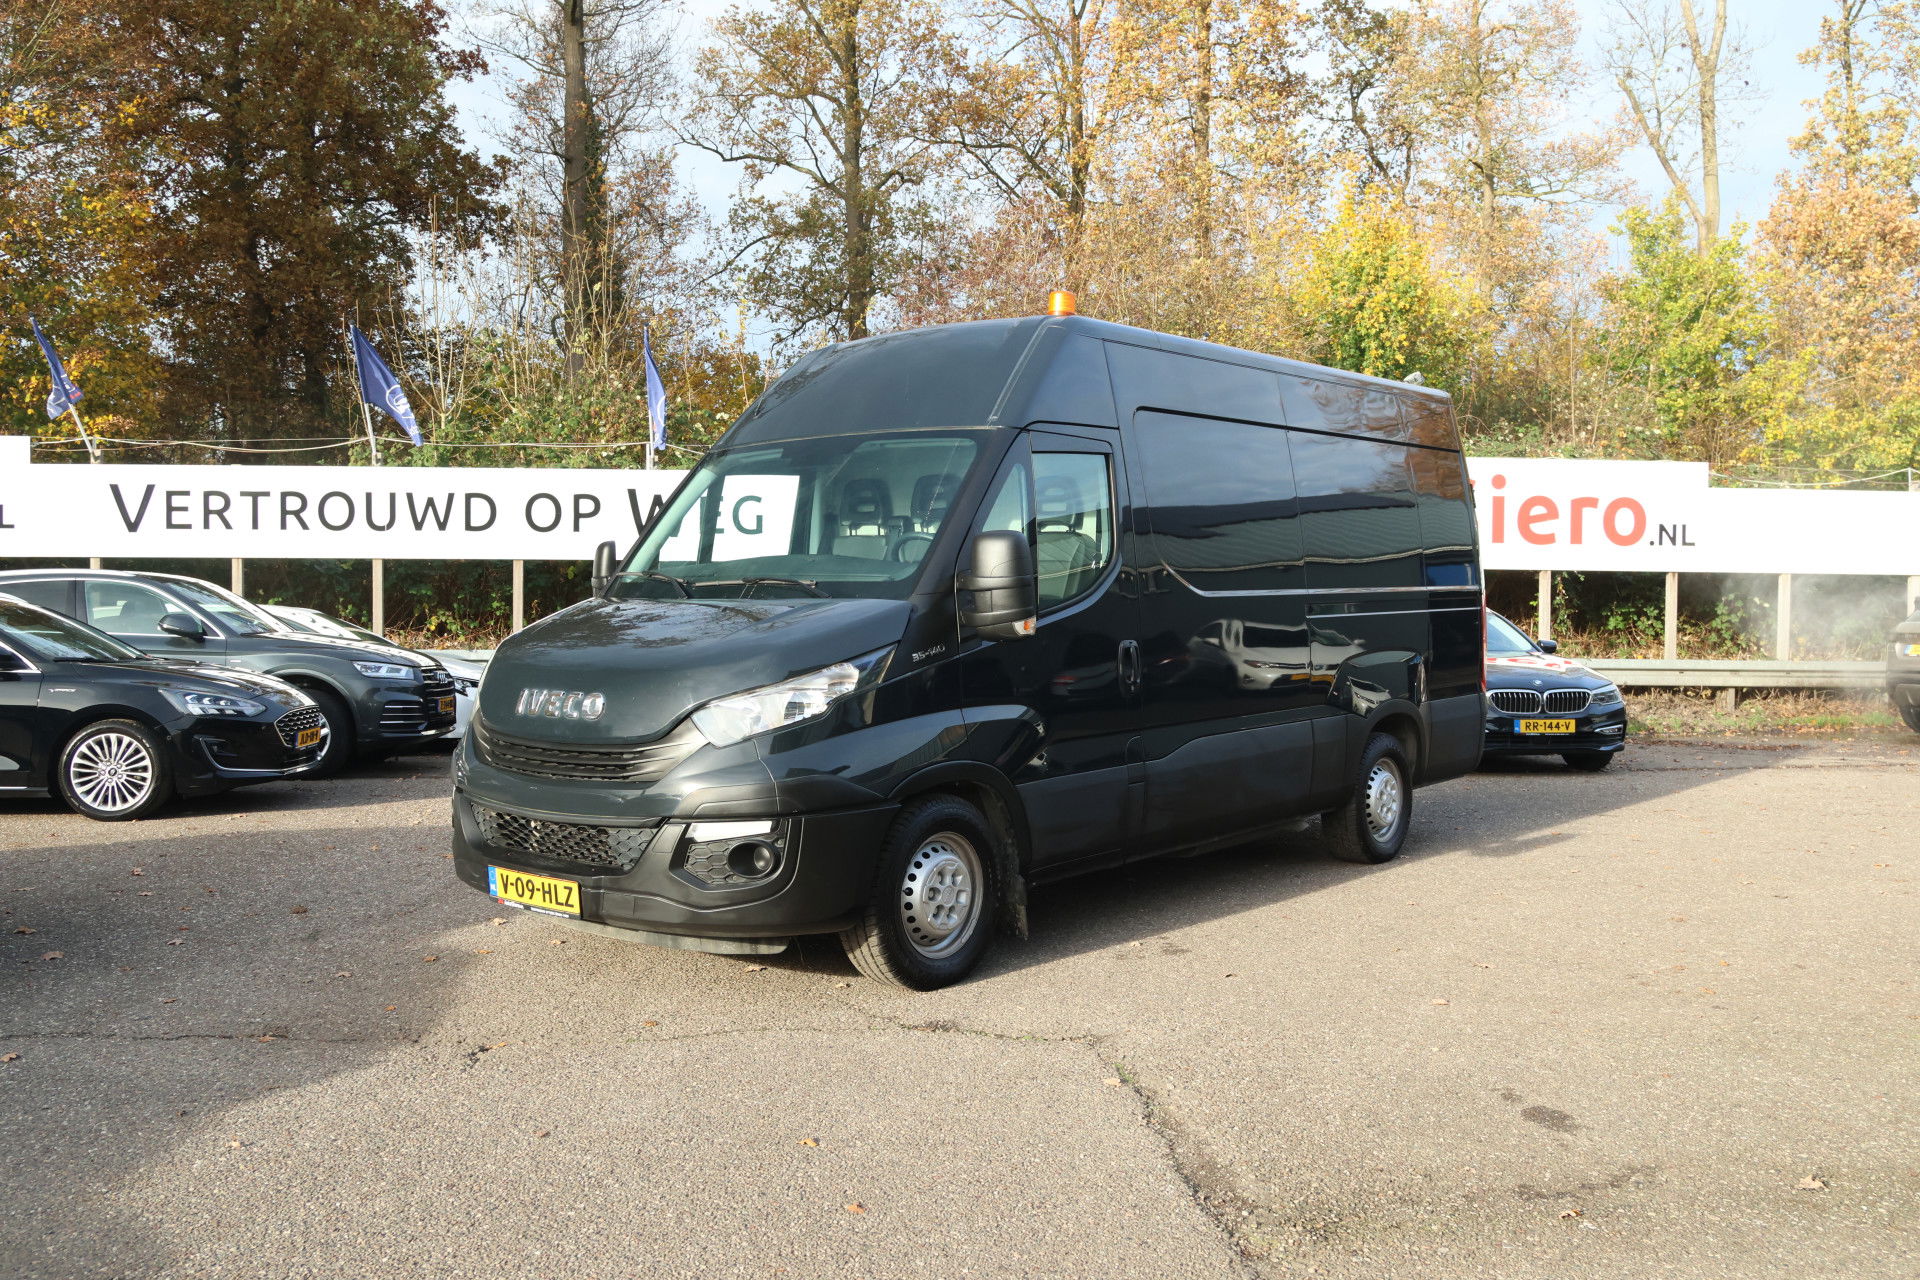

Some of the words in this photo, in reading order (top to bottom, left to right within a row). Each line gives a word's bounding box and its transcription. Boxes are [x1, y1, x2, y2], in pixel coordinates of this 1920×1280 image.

[109, 484, 497, 532] VERTROUWD
[525, 492, 601, 533] OP
[1470, 474, 1695, 546] iero.NL
[515, 688, 605, 721] IVECO
[1525, 722, 1570, 731] RR-144-V
[500, 873, 574, 908] V-09-HLZ
